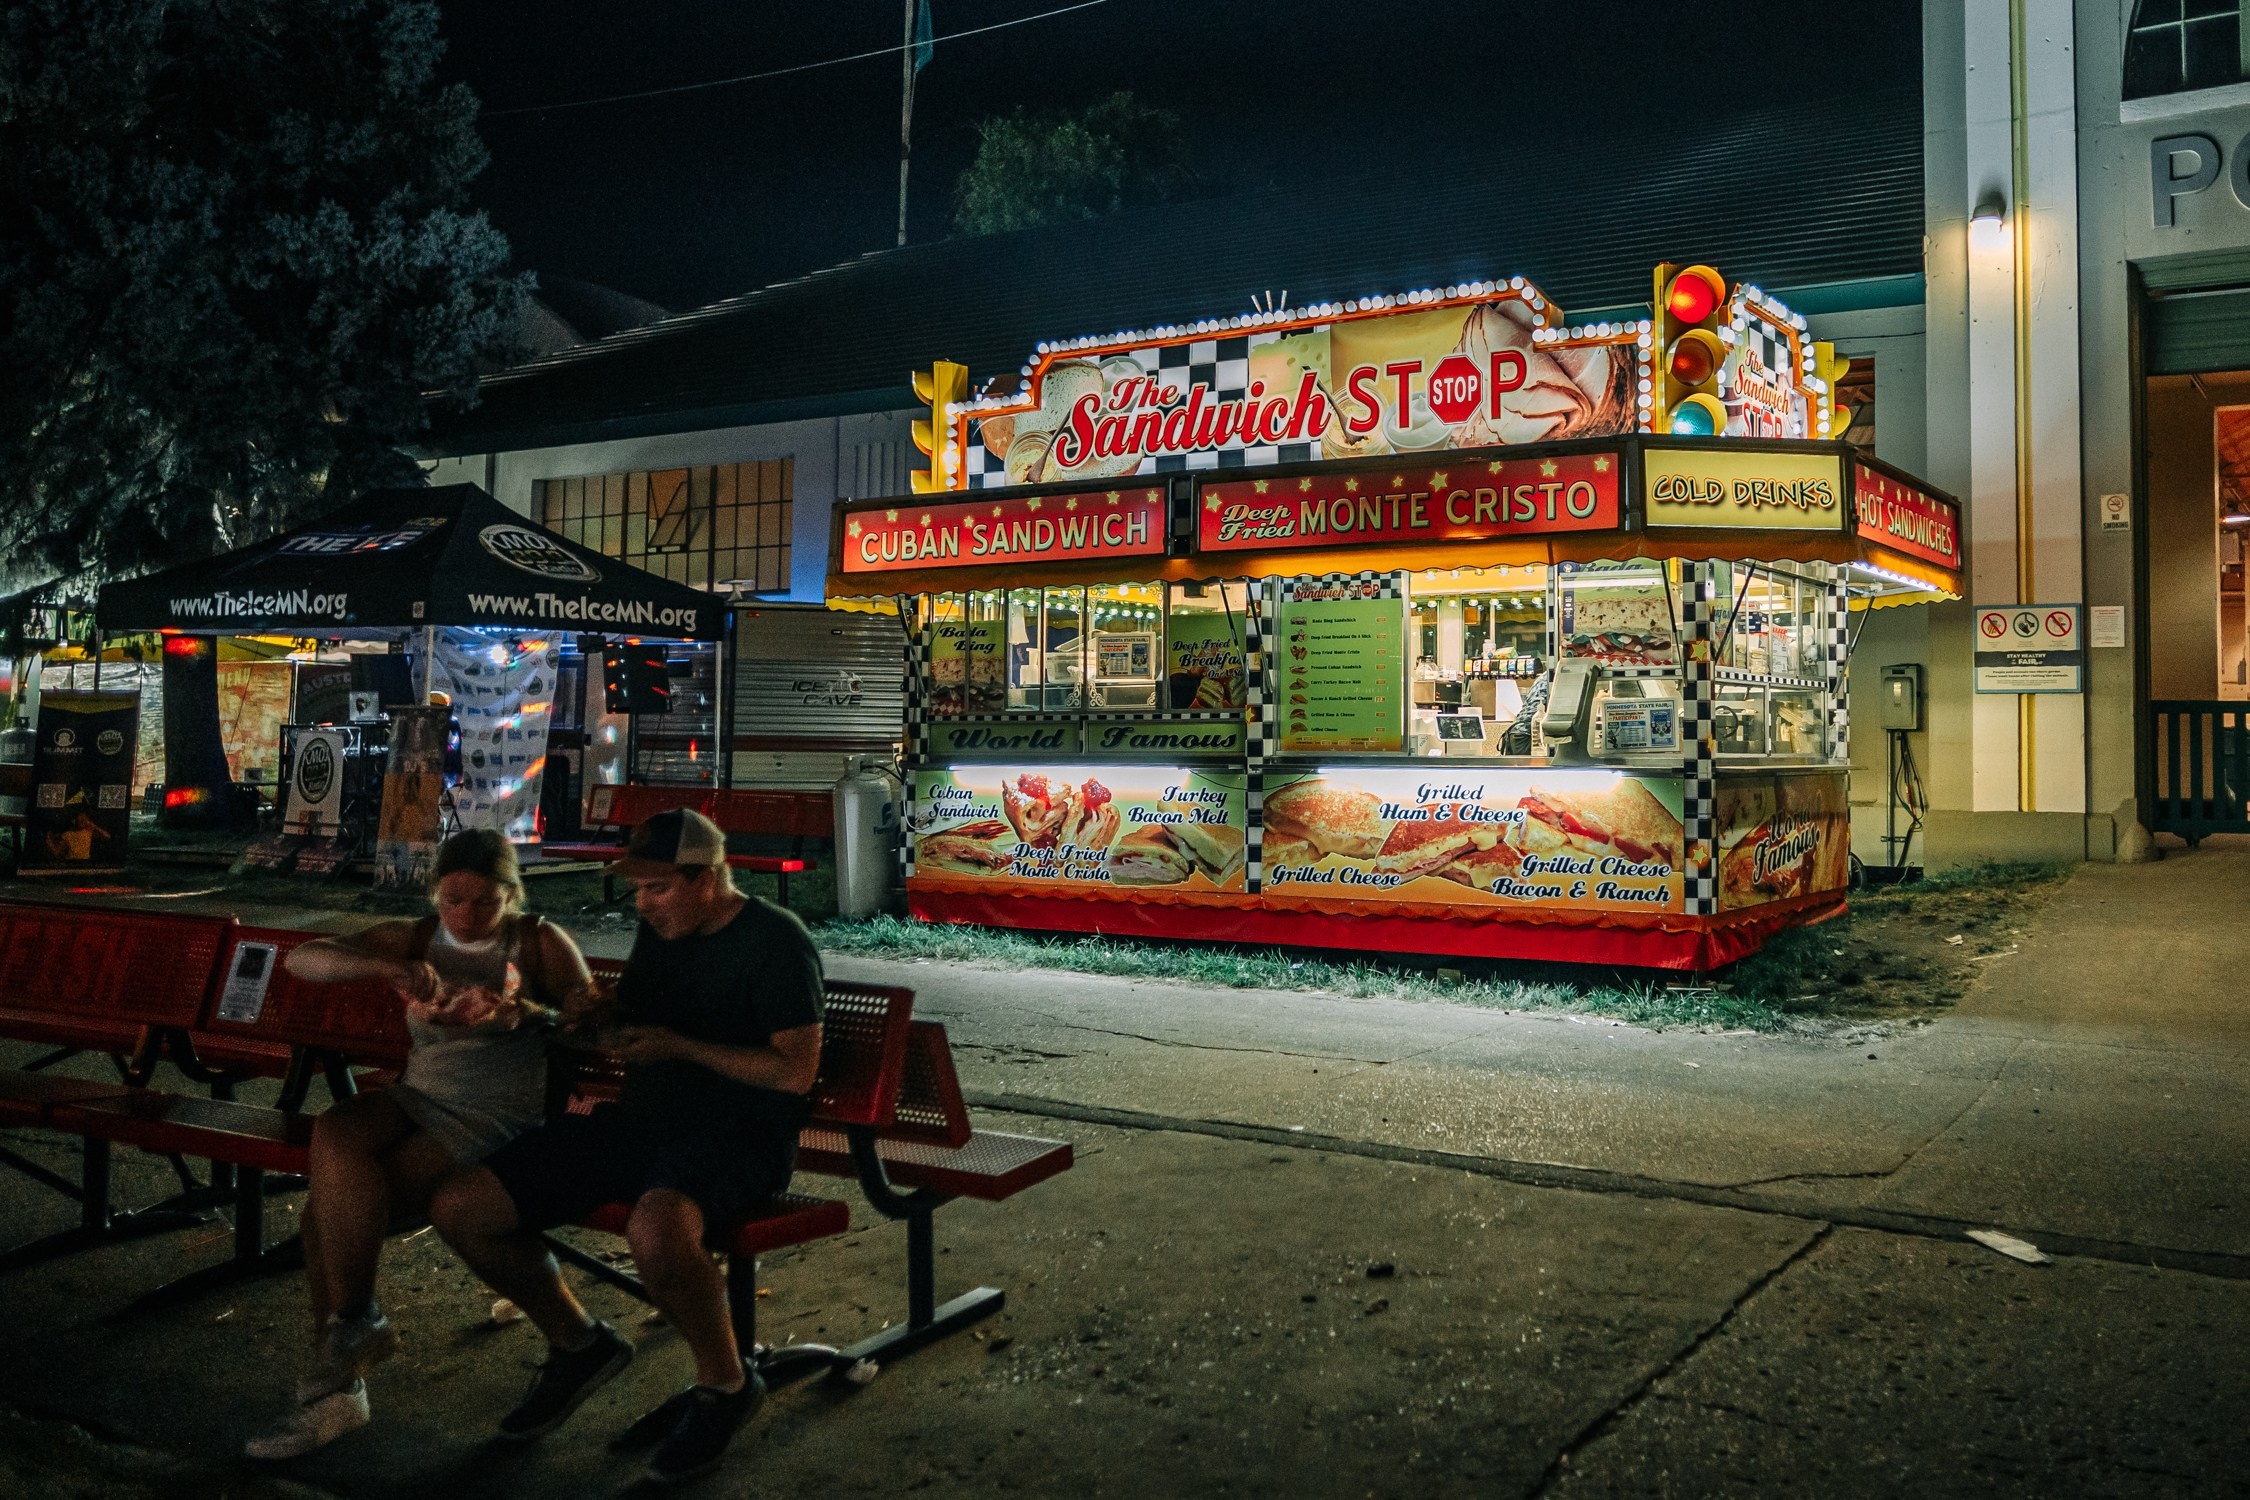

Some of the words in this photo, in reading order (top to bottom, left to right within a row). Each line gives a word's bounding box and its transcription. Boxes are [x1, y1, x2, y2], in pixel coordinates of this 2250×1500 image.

[2151, 131, 2250, 229] P
[1746, 349, 1764, 374] The
[1108, 375, 1181, 412] The
[1432, 374, 1479, 406] STOP
[1734, 364, 1790, 416] Sandwich
[1056, 369, 1332, 469] Sandwich
[1653, 475, 1724, 503] COLD
[1733, 478, 1836, 509] DRINKS
[1221, 503, 1292, 526] Deep
[1301, 491, 1430, 535] MONTE
[1445, 480, 1598, 526] CRISTO
[1217, 519, 1295, 542] Fried
[1859, 488, 1885, 527] HOT
[1888, 500, 1954, 556] SANDWICHES
[861, 526, 959, 563] CUBAN
[971, 511, 1148, 555] SANDWICH
[1293, 584, 1346, 600] Sandwich
[170, 588, 348, 620] www.TheIceMN.org
[468, 593, 697, 632] www.TheIceMN.org
[1172, 641, 1199, 654] Deep
[1200, 638, 1231, 649] Fried
[1208, 670, 1219, 678] On
[792, 681, 824, 692] ICE
[802, 694, 862, 704] CAVE
[949, 728, 1065, 749] World
[1100, 726, 1236, 748] Famous
[928, 784, 974, 800] Cuban
[1162, 786, 1229, 807] Turkey
[1416, 782, 1485, 804] Grilled
[928, 801, 1000, 820] Sandwich
[1128, 806, 1185, 824] Bacon
[1189, 808, 1229, 825] Melt
[1379, 803, 1436, 822] Ham
[1438, 804, 1452, 821] &
[1458, 803, 1527, 824] Cheese
[1012, 842, 1057, 863] Deep
[1058, 843, 1108, 861] Fried
[1008, 862, 1060, 878] Monte
[1063, 863, 1112, 881] Cristo
[1270, 864, 1335, 887] Grilled
[1338, 864, 1402, 887] Cheese
[1520, 853, 1596, 878] Grilled
[1599, 854, 1672, 879] Cheese
[1491, 877, 1564, 899] Bacon
[1568, 880, 1589, 900] &
[1595, 881, 1672, 903] Ranch
